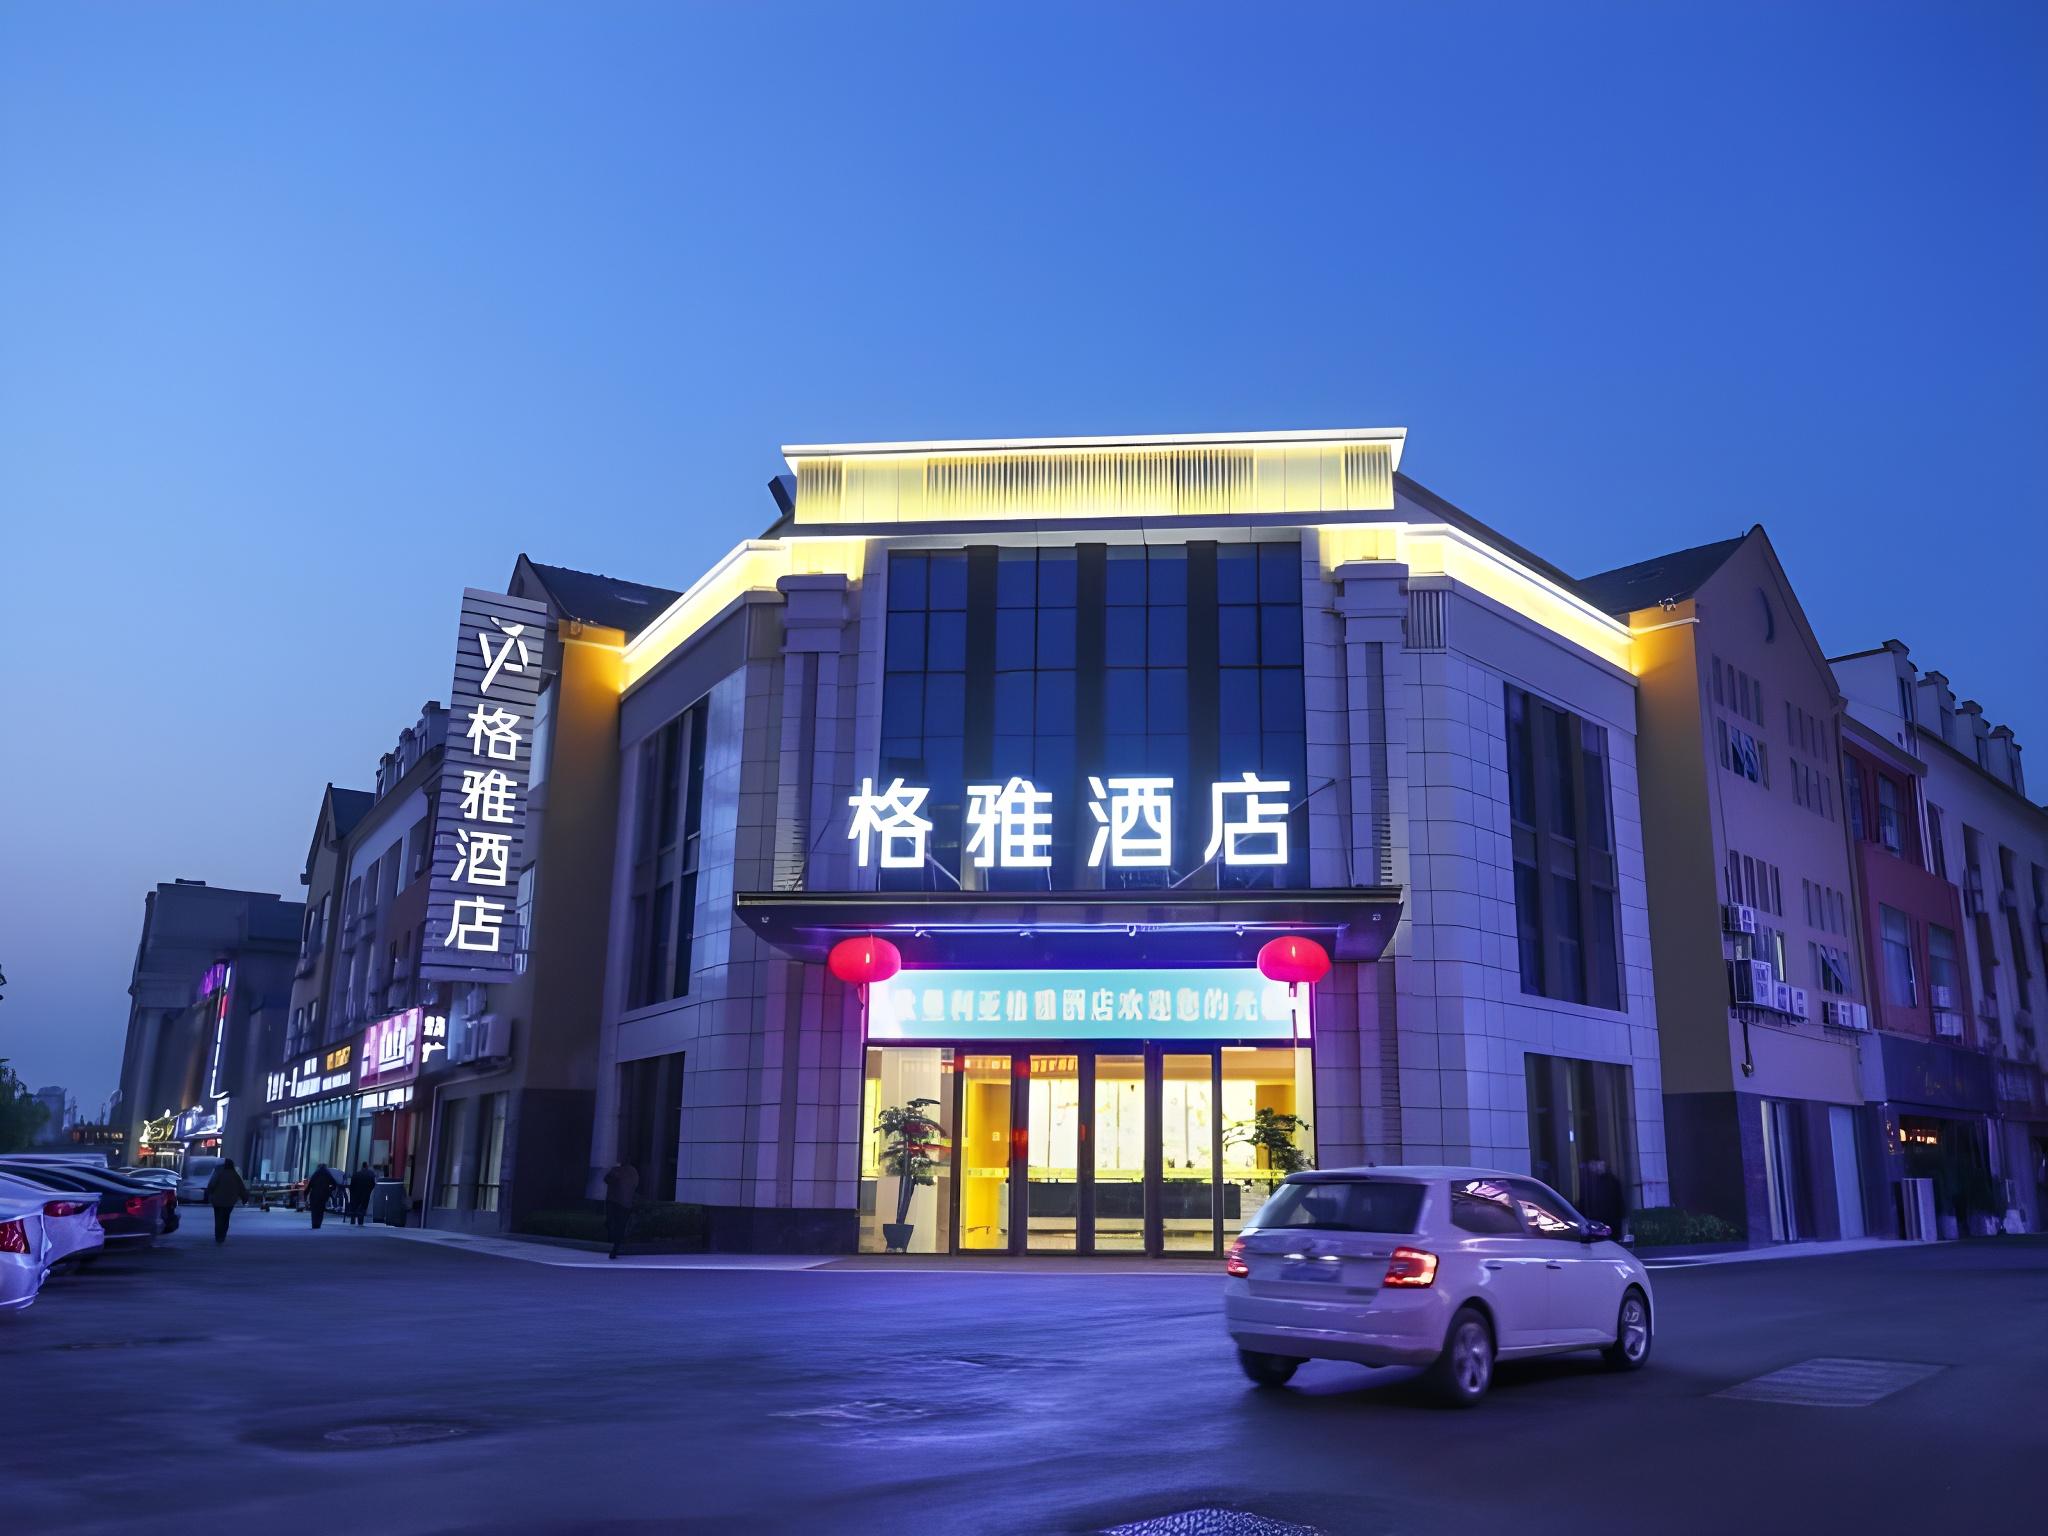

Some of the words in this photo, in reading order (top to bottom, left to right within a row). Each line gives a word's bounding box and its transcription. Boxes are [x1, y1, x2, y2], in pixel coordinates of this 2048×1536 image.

[444, 704, 522, 952] 格雅酒店
[847, 772, 1290, 868] 格雅酒店
